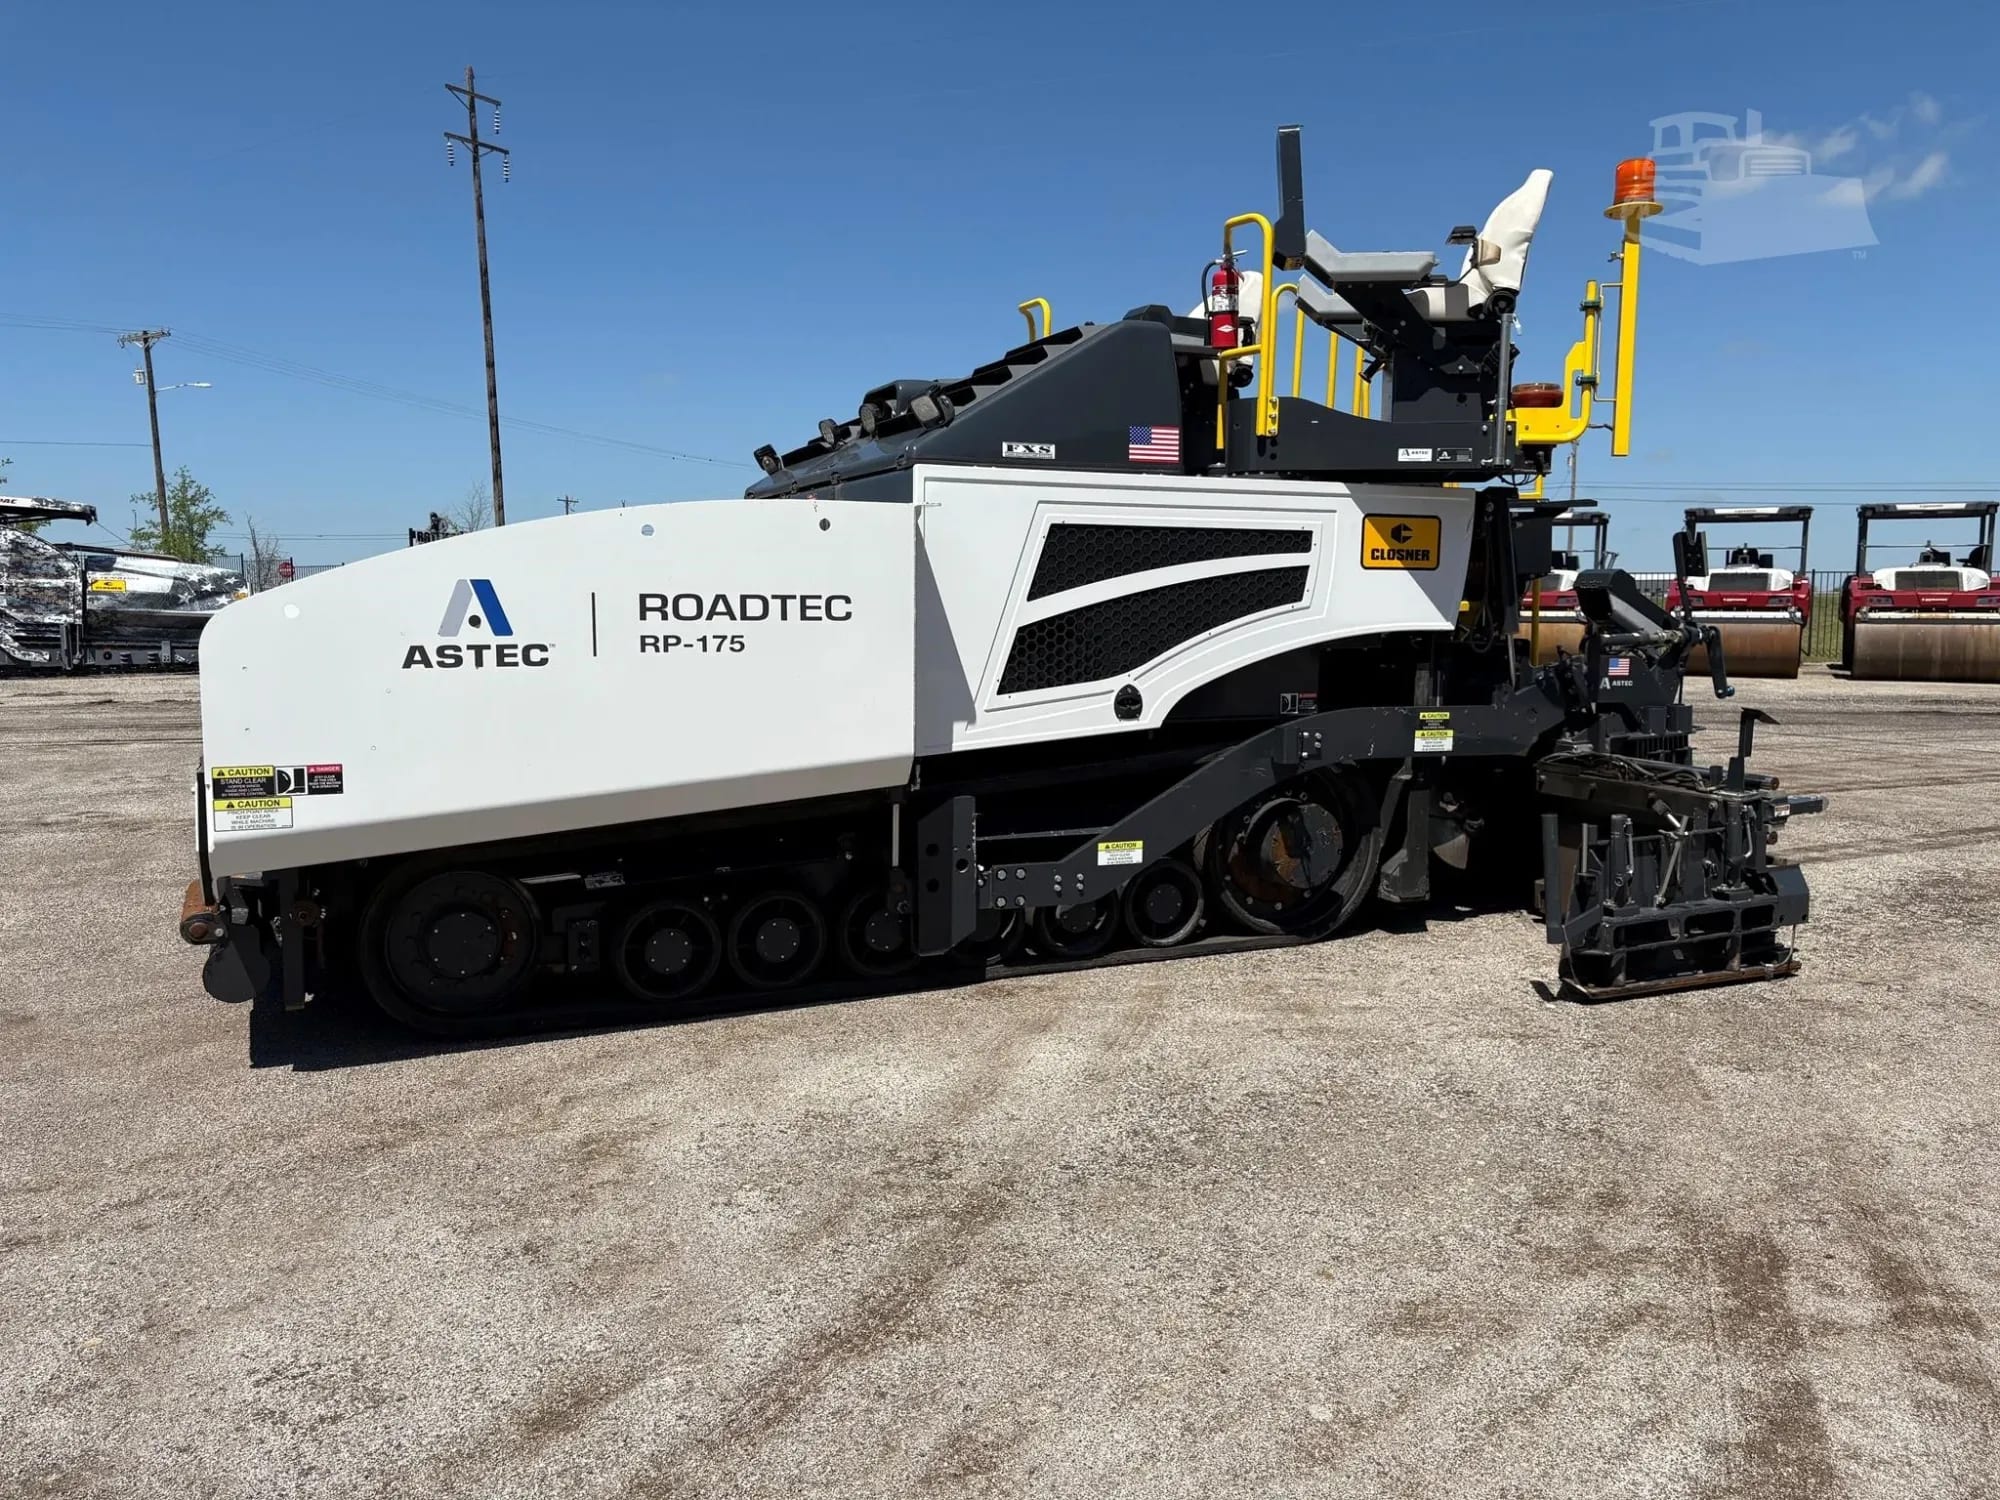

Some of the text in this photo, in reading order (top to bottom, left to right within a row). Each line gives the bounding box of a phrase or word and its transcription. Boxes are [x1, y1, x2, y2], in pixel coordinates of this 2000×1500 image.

[1371, 548, 1430, 561] CLOSNER
[638, 593, 853, 622] ROADTEC
[640, 635, 746, 653] RP-175
[402, 643, 549, 669] ASTEC
[227, 767, 270, 777] CAUTION
[237, 799, 281, 809] CAUTION
